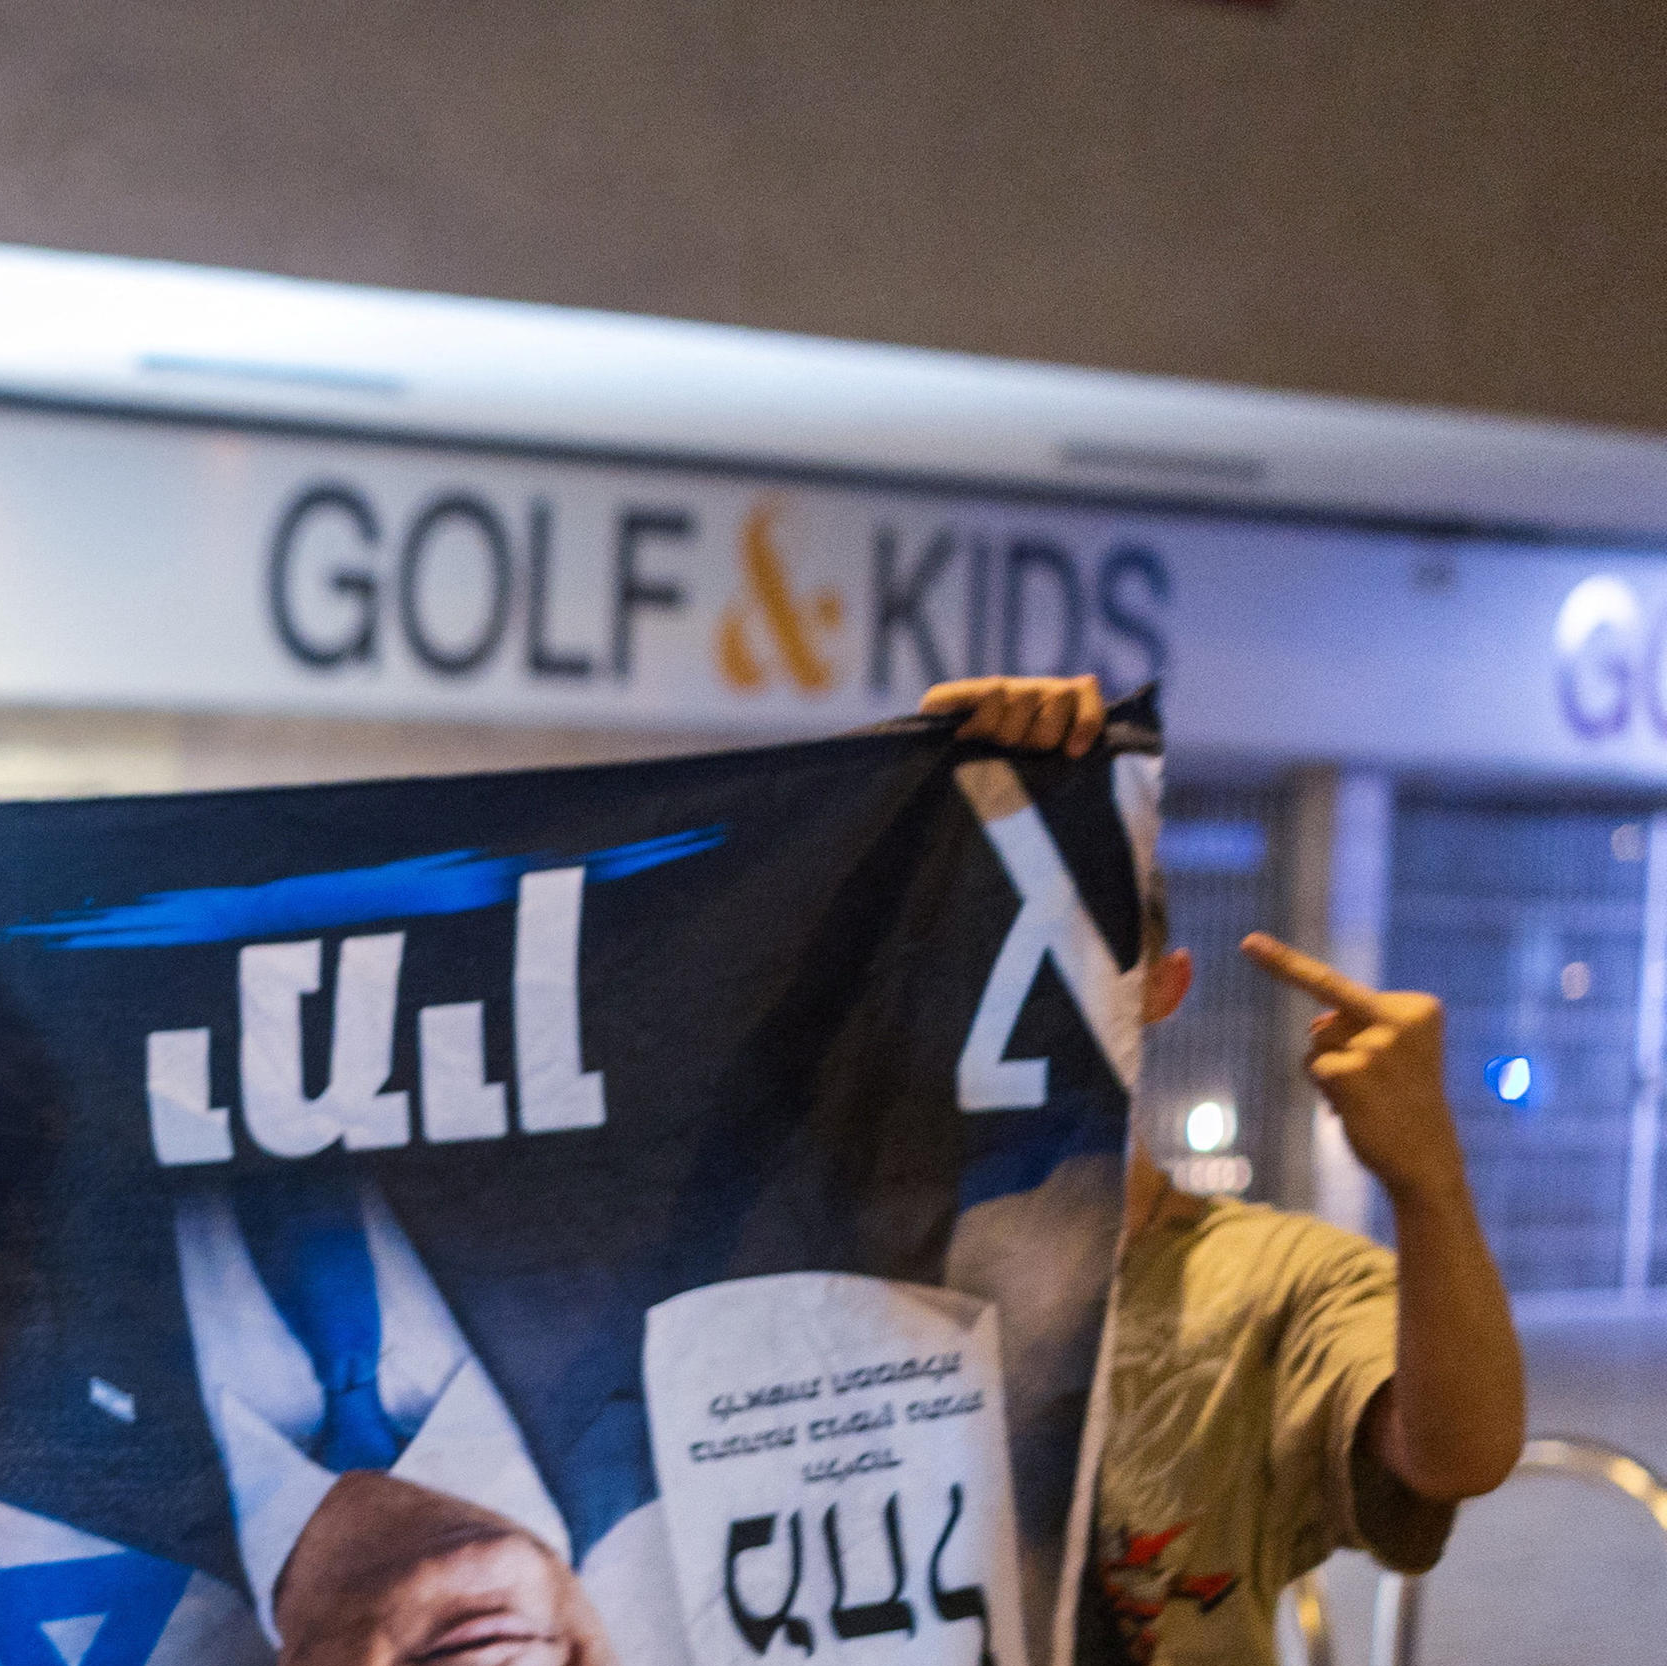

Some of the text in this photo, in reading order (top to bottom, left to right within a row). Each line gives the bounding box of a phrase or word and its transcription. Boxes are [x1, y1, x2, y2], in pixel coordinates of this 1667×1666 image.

[265, 482, 1170, 696] GOLF & KIDS
[1552, 572, 1667, 744] G
[146, 865, 608, 1167] ימין
